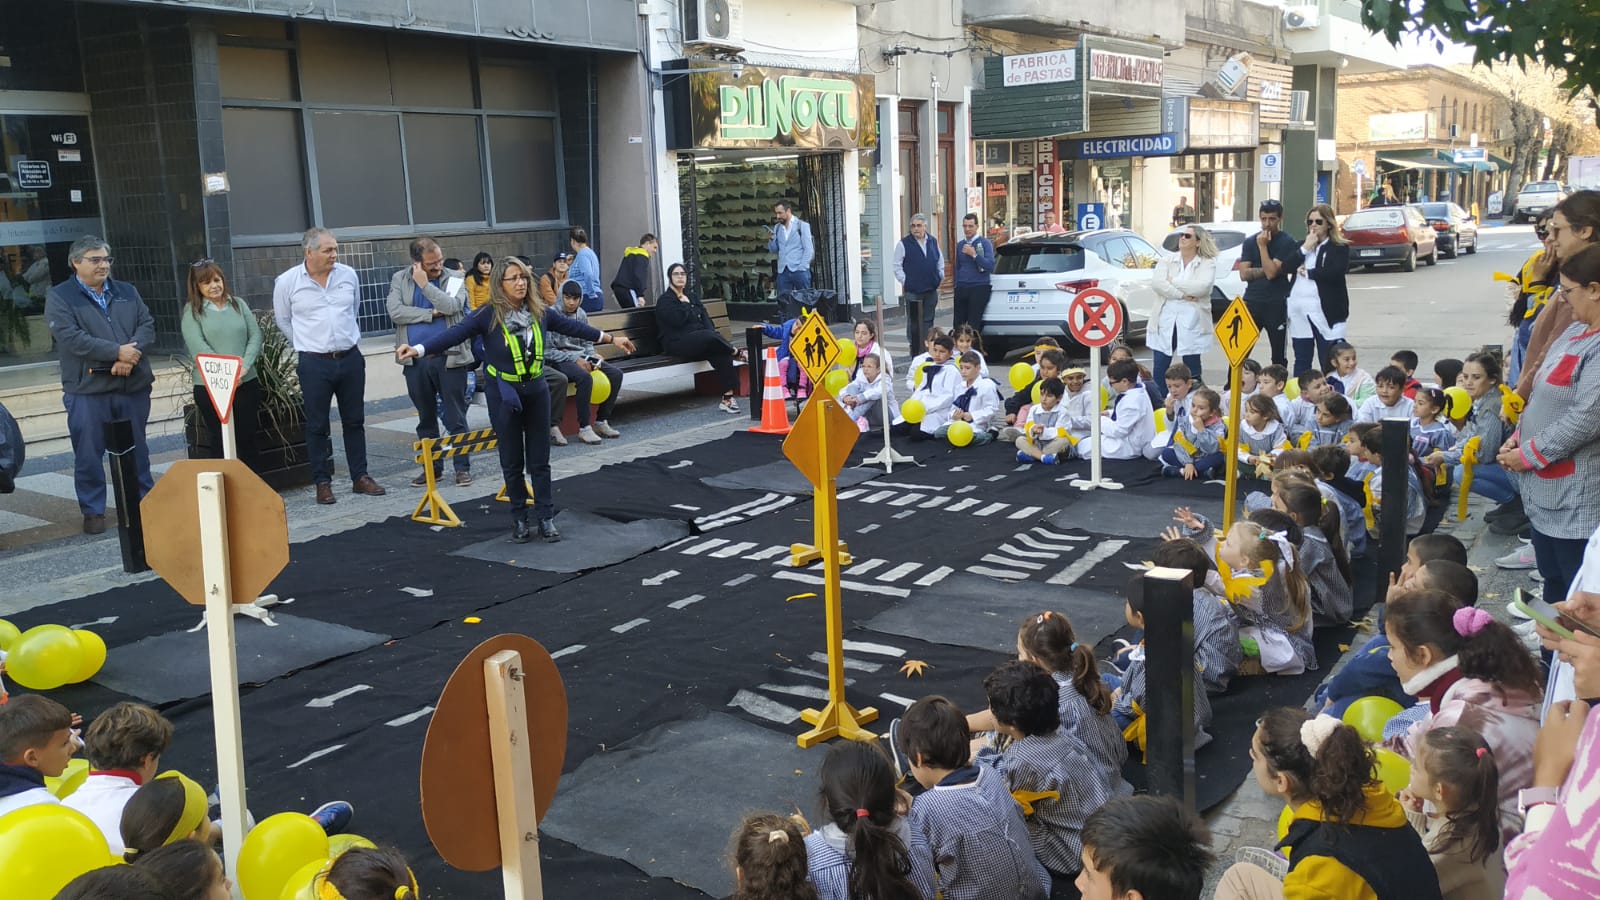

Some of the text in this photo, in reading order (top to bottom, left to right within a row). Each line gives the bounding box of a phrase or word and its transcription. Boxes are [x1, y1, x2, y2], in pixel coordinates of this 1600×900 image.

[1011, 54, 1067, 69] FABRICA
[1006, 67, 1072, 83] de PASTAS
[1083, 137, 1172, 154] ELECTRICIDAD
[1086, 217, 1095, 230] E
[204, 361, 232, 376] CEDA EL
[210, 376, 229, 390] PASO
